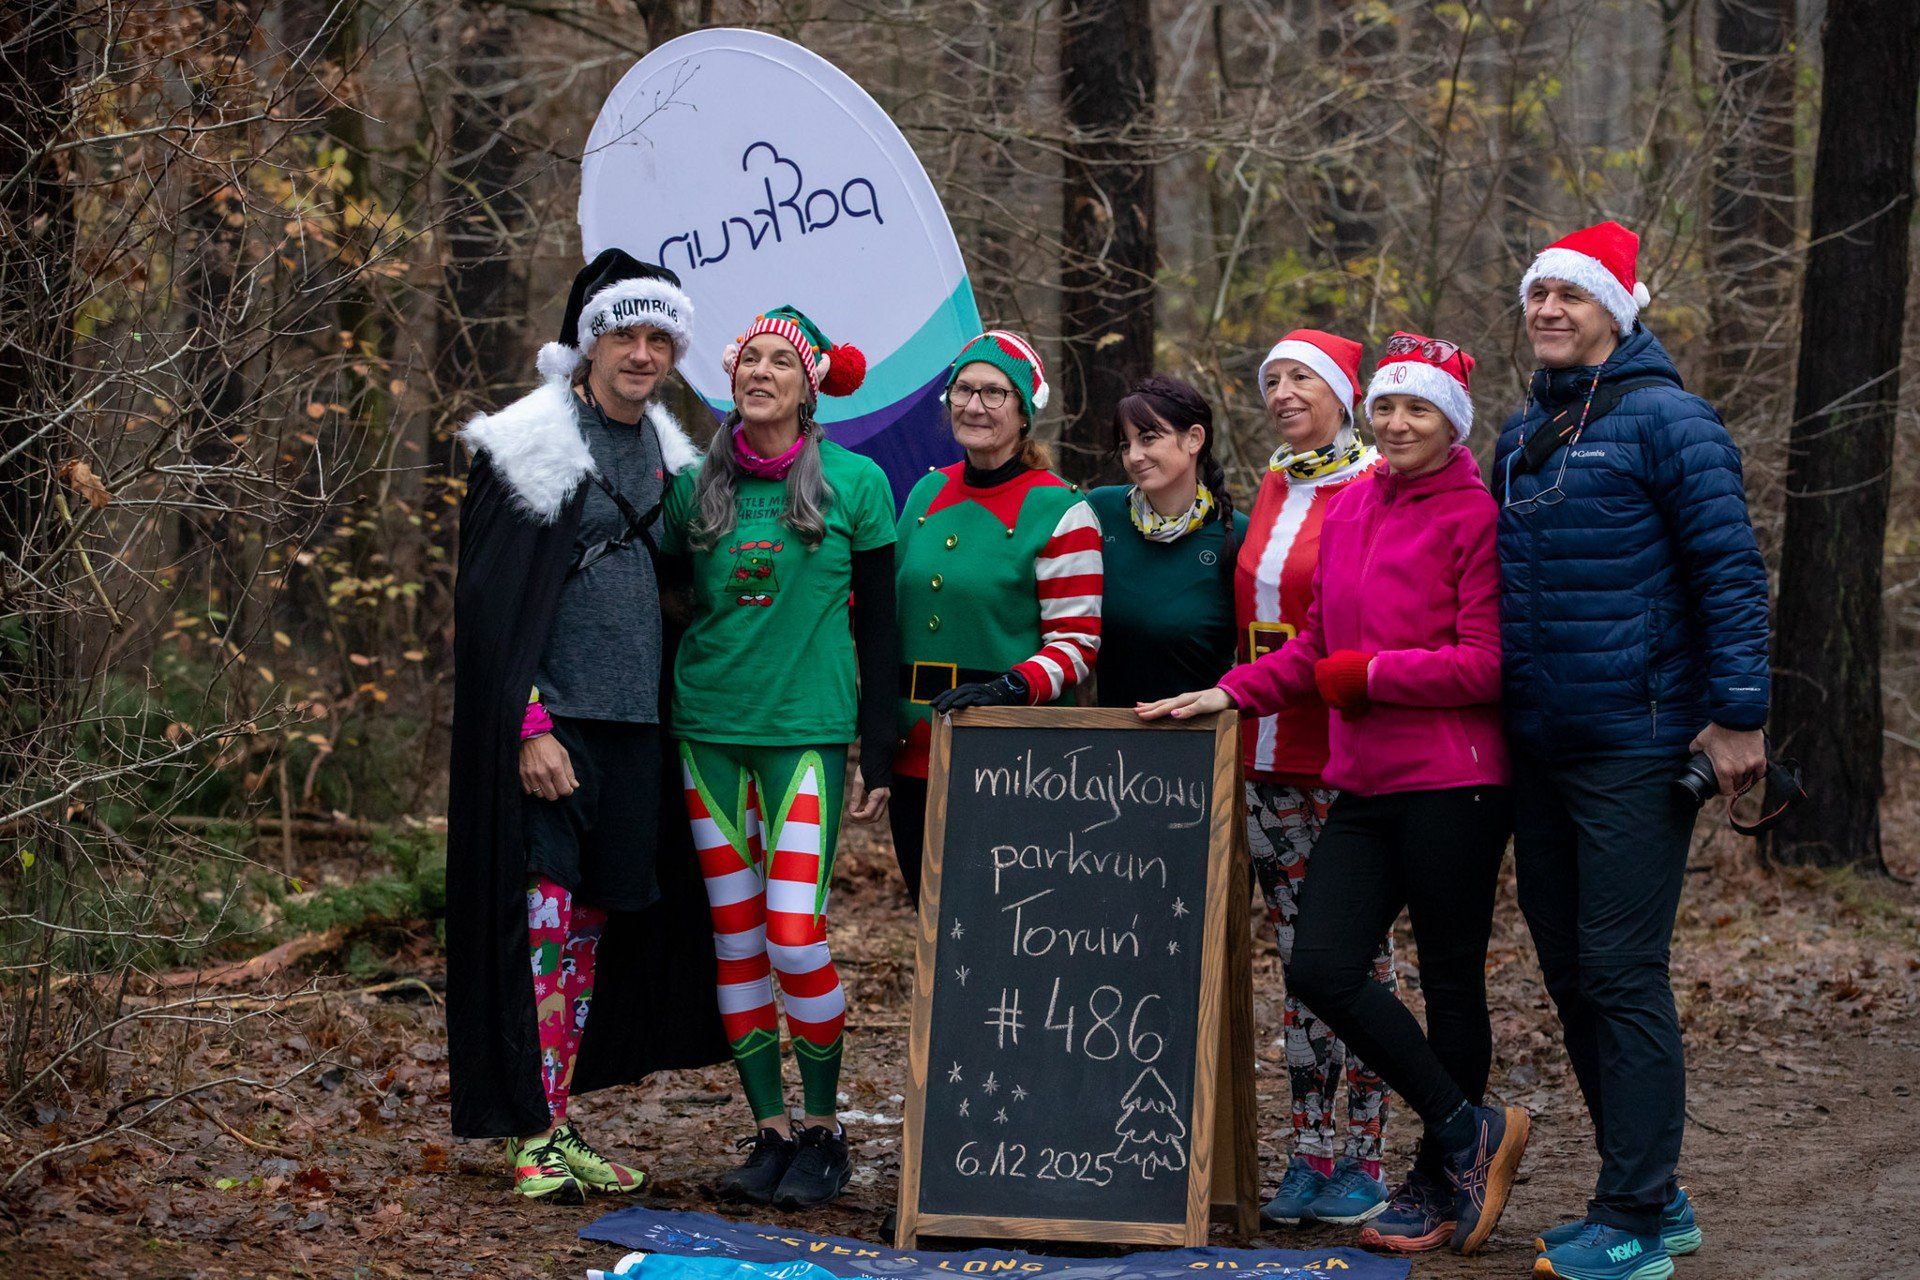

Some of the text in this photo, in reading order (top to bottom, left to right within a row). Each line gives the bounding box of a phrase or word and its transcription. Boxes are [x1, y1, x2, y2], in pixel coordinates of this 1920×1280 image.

[613, 298, 679, 323] HUMBUG
[1578, 450, 1605, 458] Columbia
[974, 745, 1206, 834] mikołajkowy
[990, 831, 1167, 896] parkrun
[1001, 888, 1140, 958] Toruń
[1606, 1238, 1643, 1263] HOKA
[938, 1258, 1045, 1273] LONG
